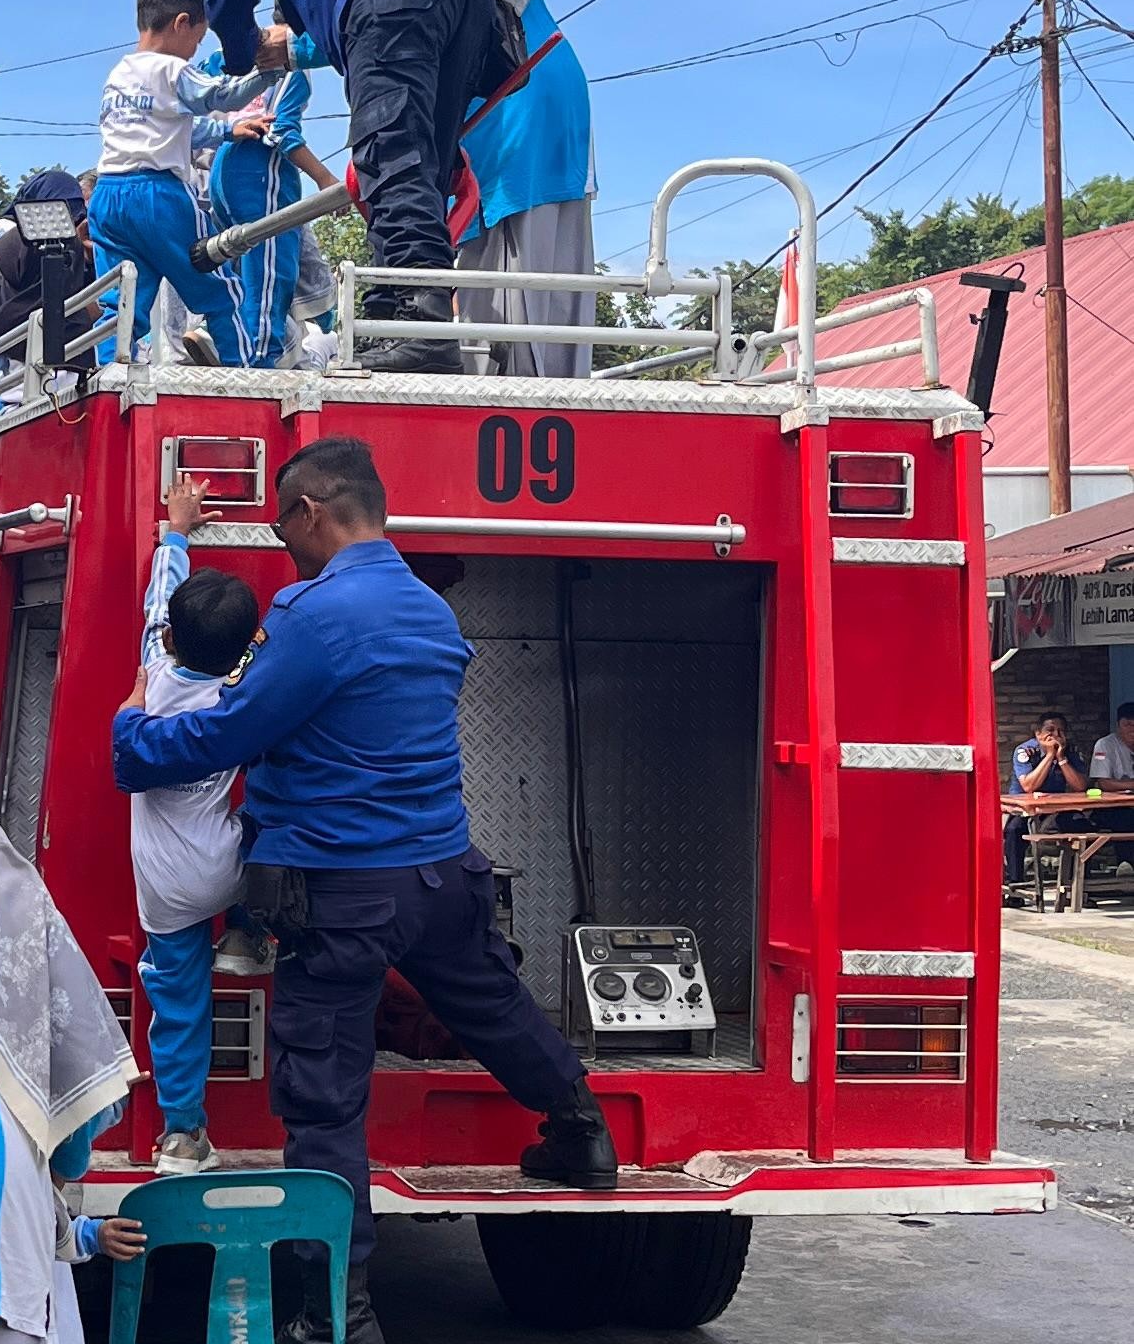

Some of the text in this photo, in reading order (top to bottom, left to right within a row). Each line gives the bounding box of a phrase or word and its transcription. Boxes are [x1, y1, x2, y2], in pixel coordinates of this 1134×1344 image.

[477, 415, 575, 504] 09
[1083, 581, 1101, 600] 40%
[1081, 606, 1134, 626] Lebih Lama
